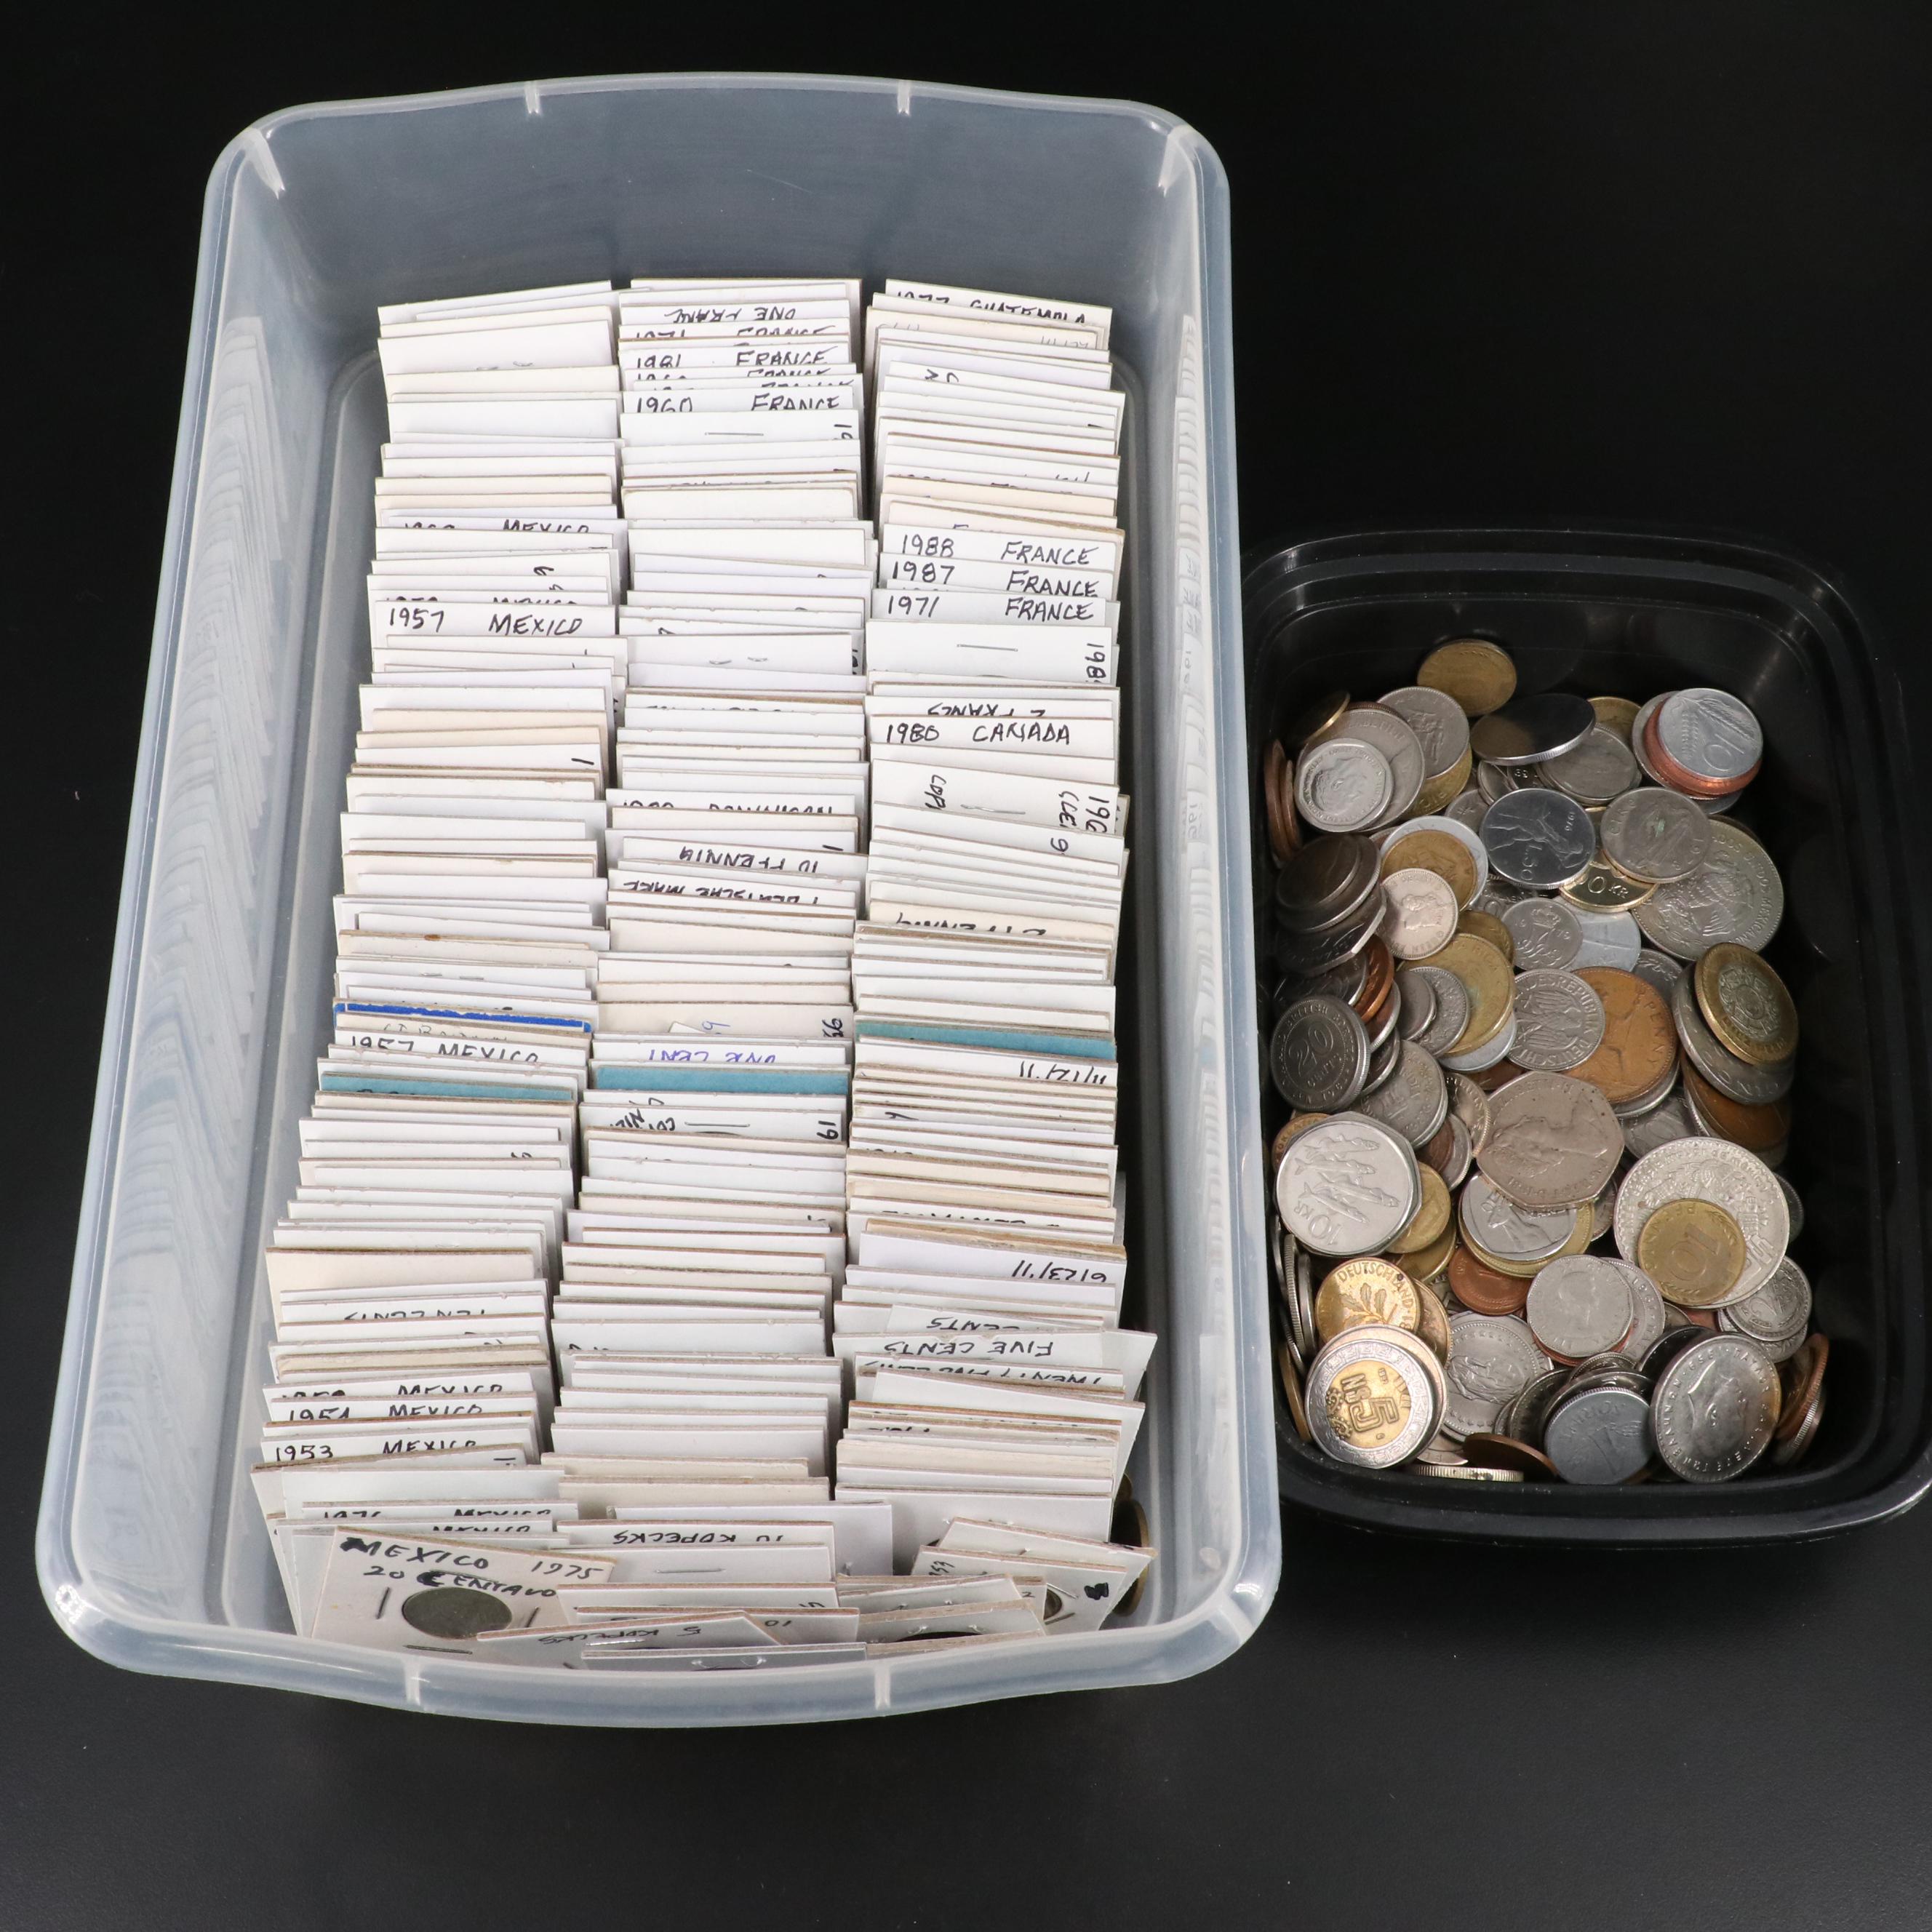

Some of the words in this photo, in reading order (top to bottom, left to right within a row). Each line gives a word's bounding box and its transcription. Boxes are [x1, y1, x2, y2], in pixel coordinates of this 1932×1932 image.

[736, 346, 839, 367] FRANCE
[751, 393, 839, 411] FRANCE
[903, 535, 954, 557] 1988
[1000, 541, 1099, 565] FRANCE
[893, 561, 955, 585] 1987
[1007, 570, 1099, 597] FRANCE
[389, 607, 445, 632] 1957
[489, 614, 583, 636] MEXICO
[888, 595, 939, 618] 1971
[1005, 597, 1094, 622] FRANCE
[884, 1341, 975, 1356] CENTS
[987, 1341, 1054, 1357] FIVE
[276, 1445, 333, 1461] 1953
[351, 1538, 489, 1570] MEXICO
[531, 1560, 603, 1580] 1975
[363, 1565, 406, 1580] 20
[417, 1570, 557, 1598] CENTAVO
